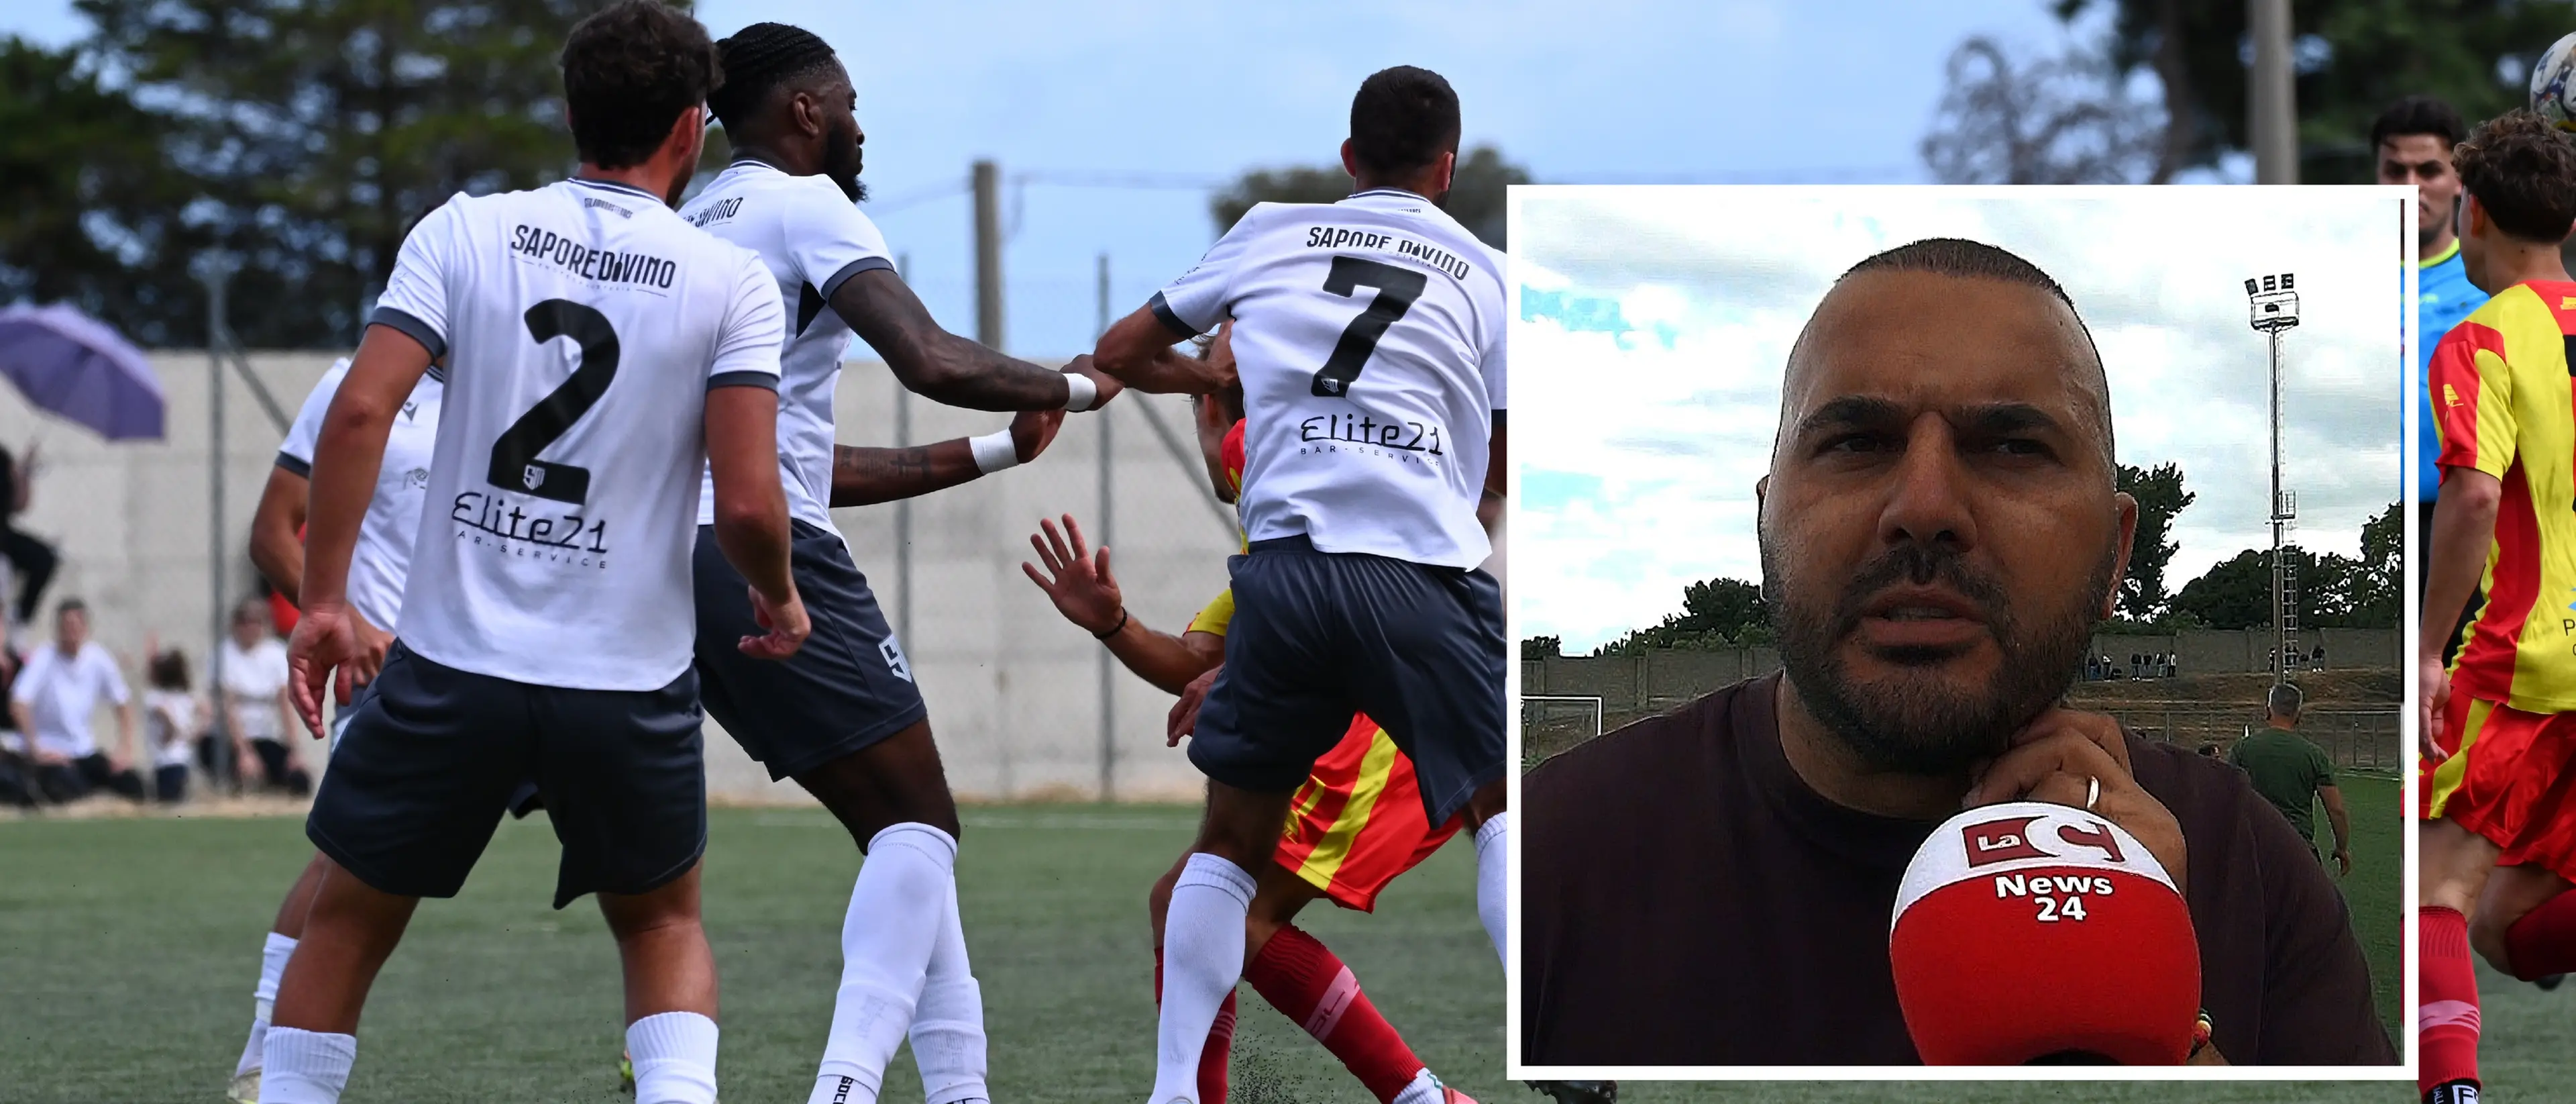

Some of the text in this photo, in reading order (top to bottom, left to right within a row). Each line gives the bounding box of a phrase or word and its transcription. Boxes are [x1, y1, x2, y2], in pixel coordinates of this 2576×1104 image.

[1311, 256, 1428, 397] 7
[488, 298, 621, 505] 2
[1301, 413, 1443, 456] Elite21
[451, 492, 608, 554] Elite21
[1994, 874, 2114, 899] News
[2034, 896, 2087, 921] 24
